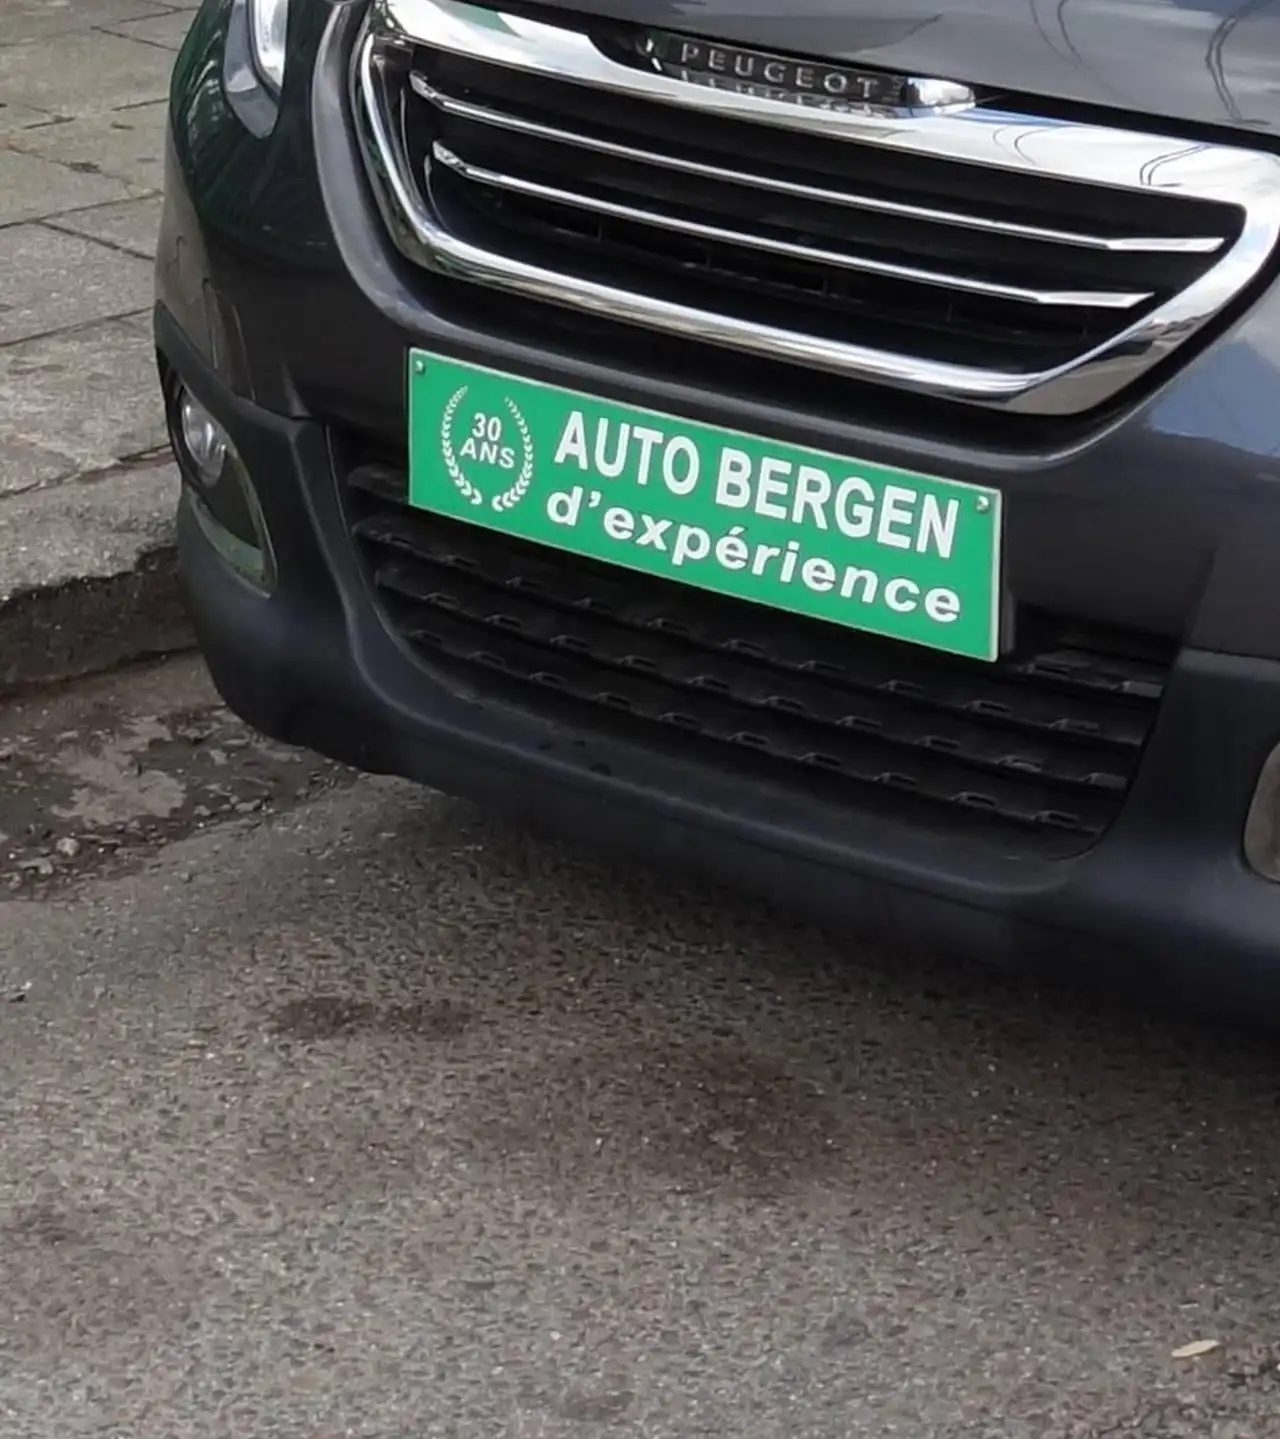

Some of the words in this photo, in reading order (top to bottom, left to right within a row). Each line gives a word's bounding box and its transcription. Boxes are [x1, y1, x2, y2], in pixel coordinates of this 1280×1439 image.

[680, 41, 881, 100] PEUGEOT
[460, 438, 515, 469] ANS
[471, 412, 502, 441] 30
[553, 410, 701, 496] AUTO
[715, 446, 960, 560] BERGEN
[546, 485, 961, 624] d'expérience
